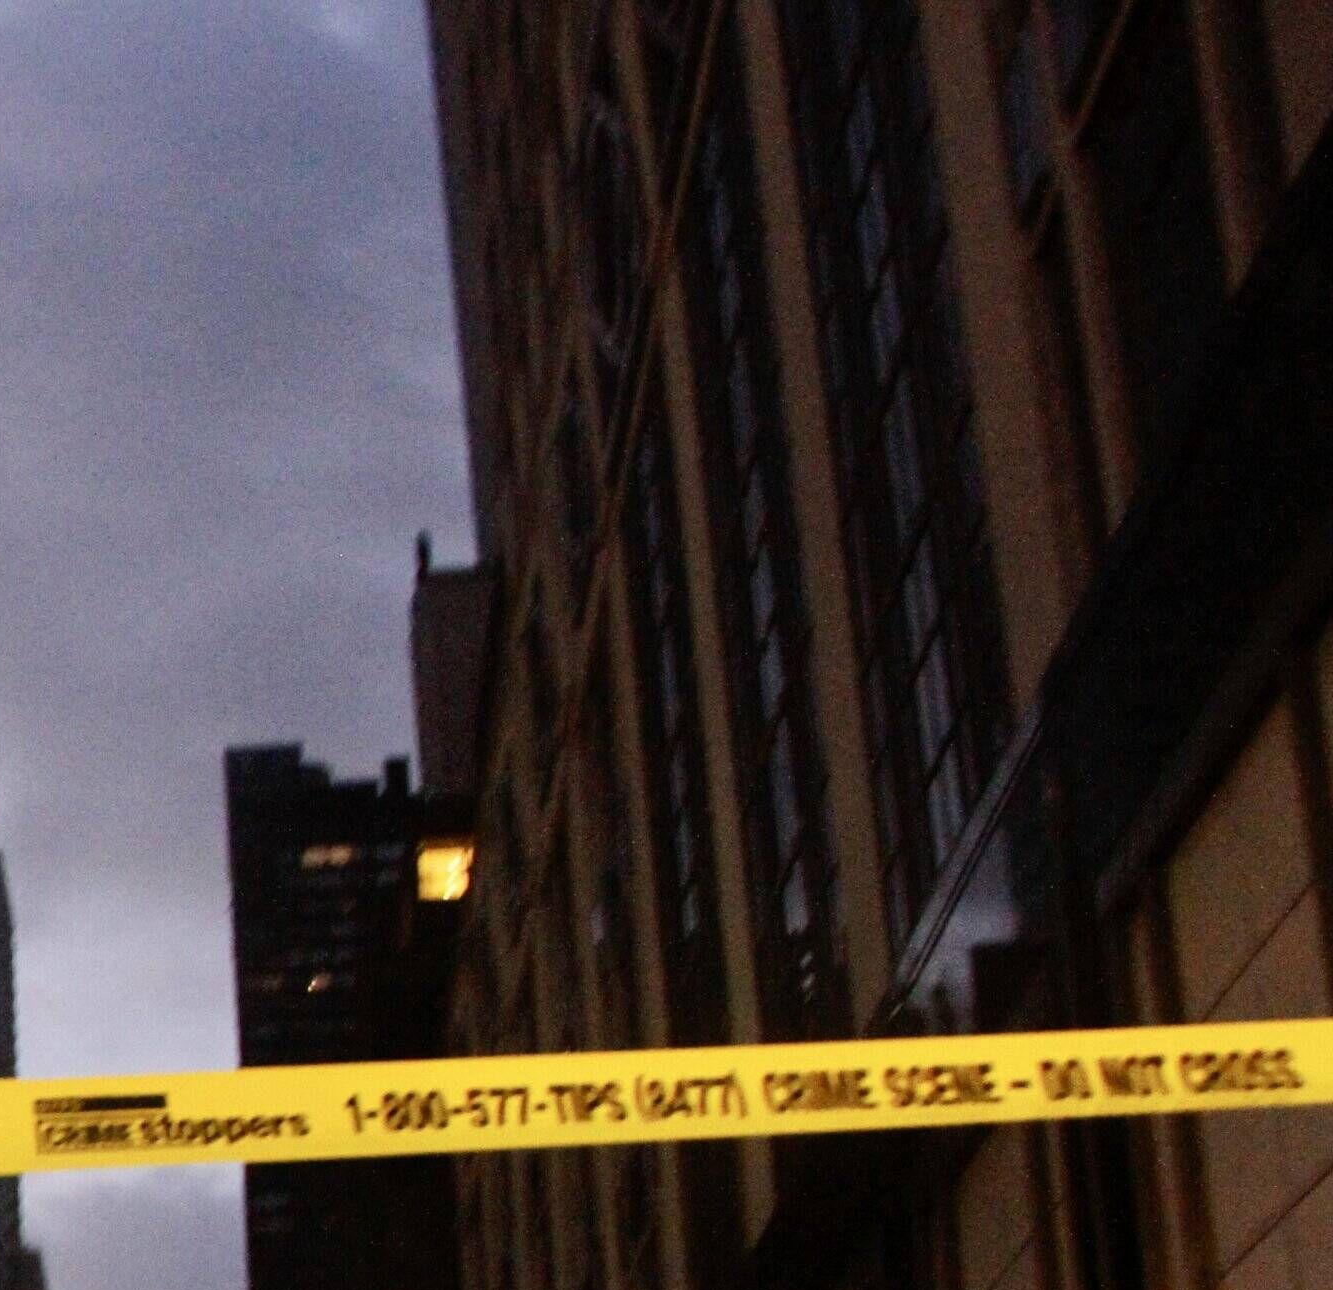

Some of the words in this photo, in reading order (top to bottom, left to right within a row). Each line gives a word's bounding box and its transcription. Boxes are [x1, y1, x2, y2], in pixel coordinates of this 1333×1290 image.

[345, 1080, 627, 1133] 1-800-577-TIPS
[635, 1068, 748, 1122] (8477)
[762, 1068, 874, 1113] CRIME
[883, 1062, 1003, 1107] SCENE
[1039, 1058, 1092, 1101] DO
[1098, 1055, 1169, 1097] NOT
[1178, 1048, 1305, 1094] CROSS
